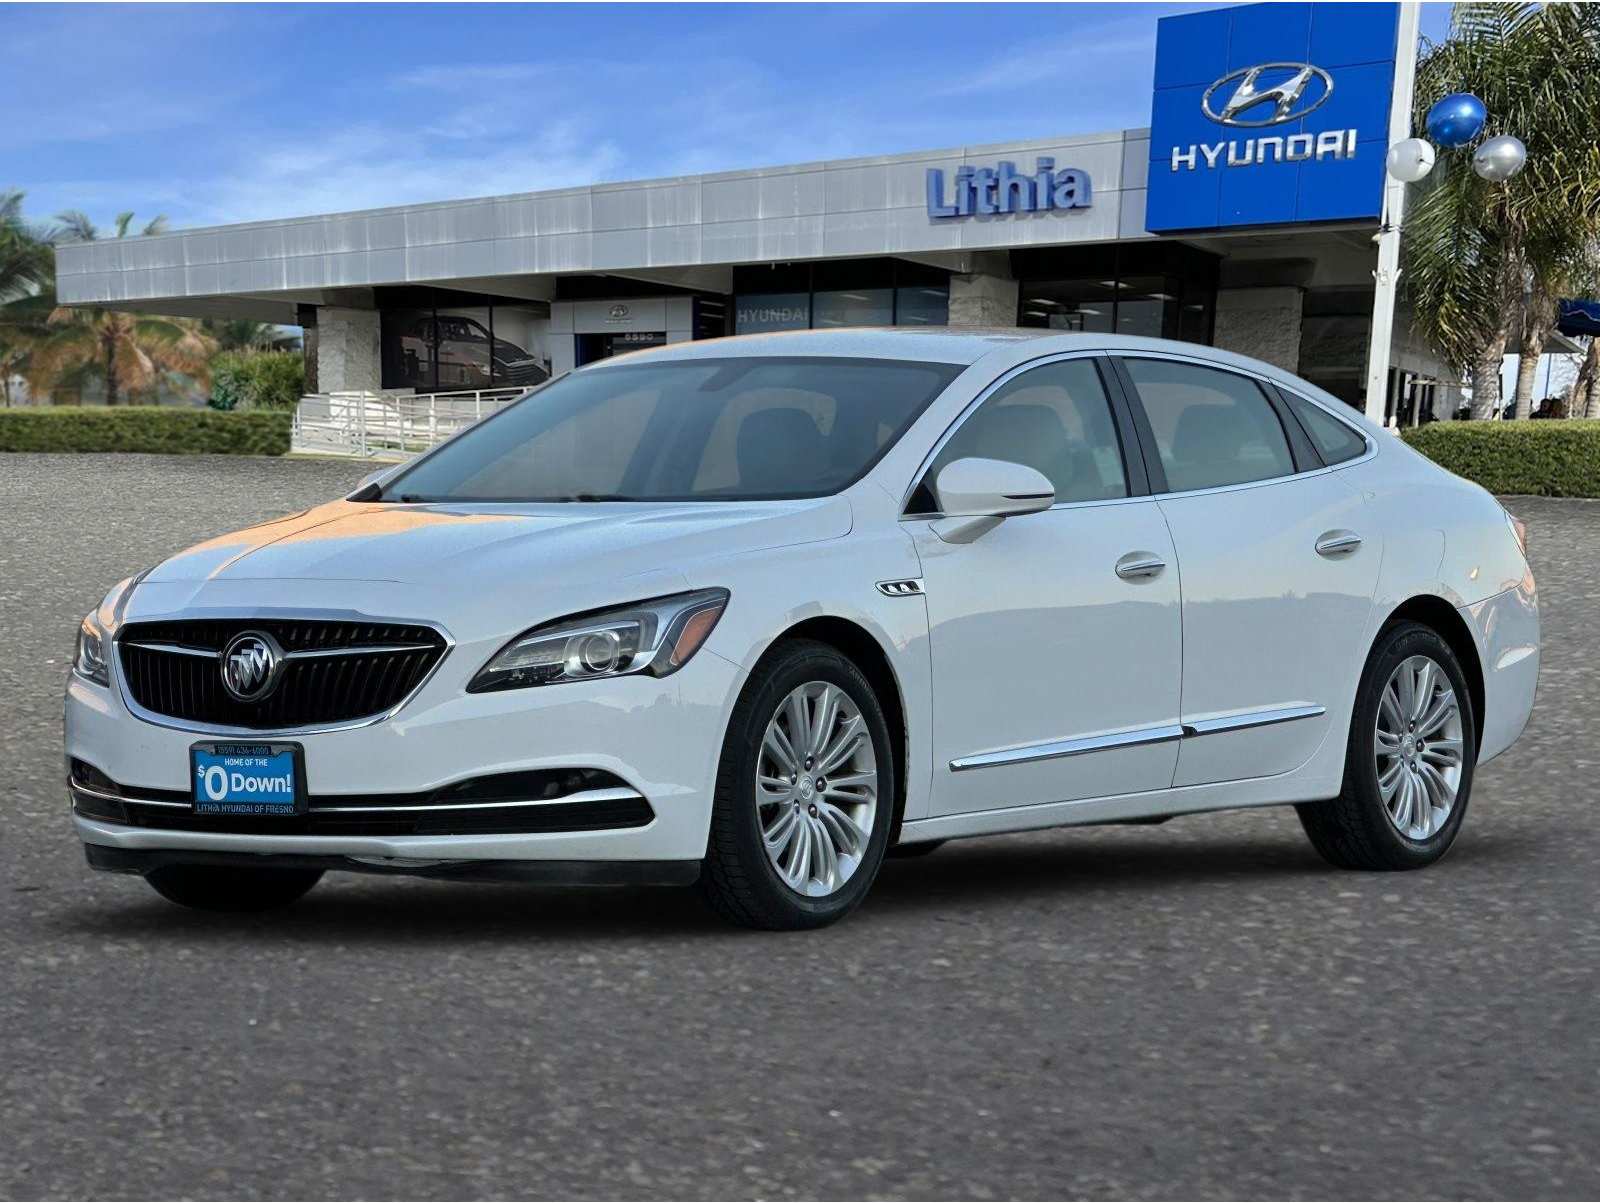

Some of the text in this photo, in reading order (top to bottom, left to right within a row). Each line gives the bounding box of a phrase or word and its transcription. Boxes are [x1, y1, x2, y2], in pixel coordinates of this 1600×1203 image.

[1171, 128, 1358, 172] HYUNDAI
[926, 156, 1093, 218] Lithia
[737, 307, 809, 323] HYUNDAI
[224, 759, 268, 767] HOME OF THE
[197, 765, 293, 801] $0 Down!
[196, 804, 295, 814] LITHIA HYUNDAI OF FRESNO
